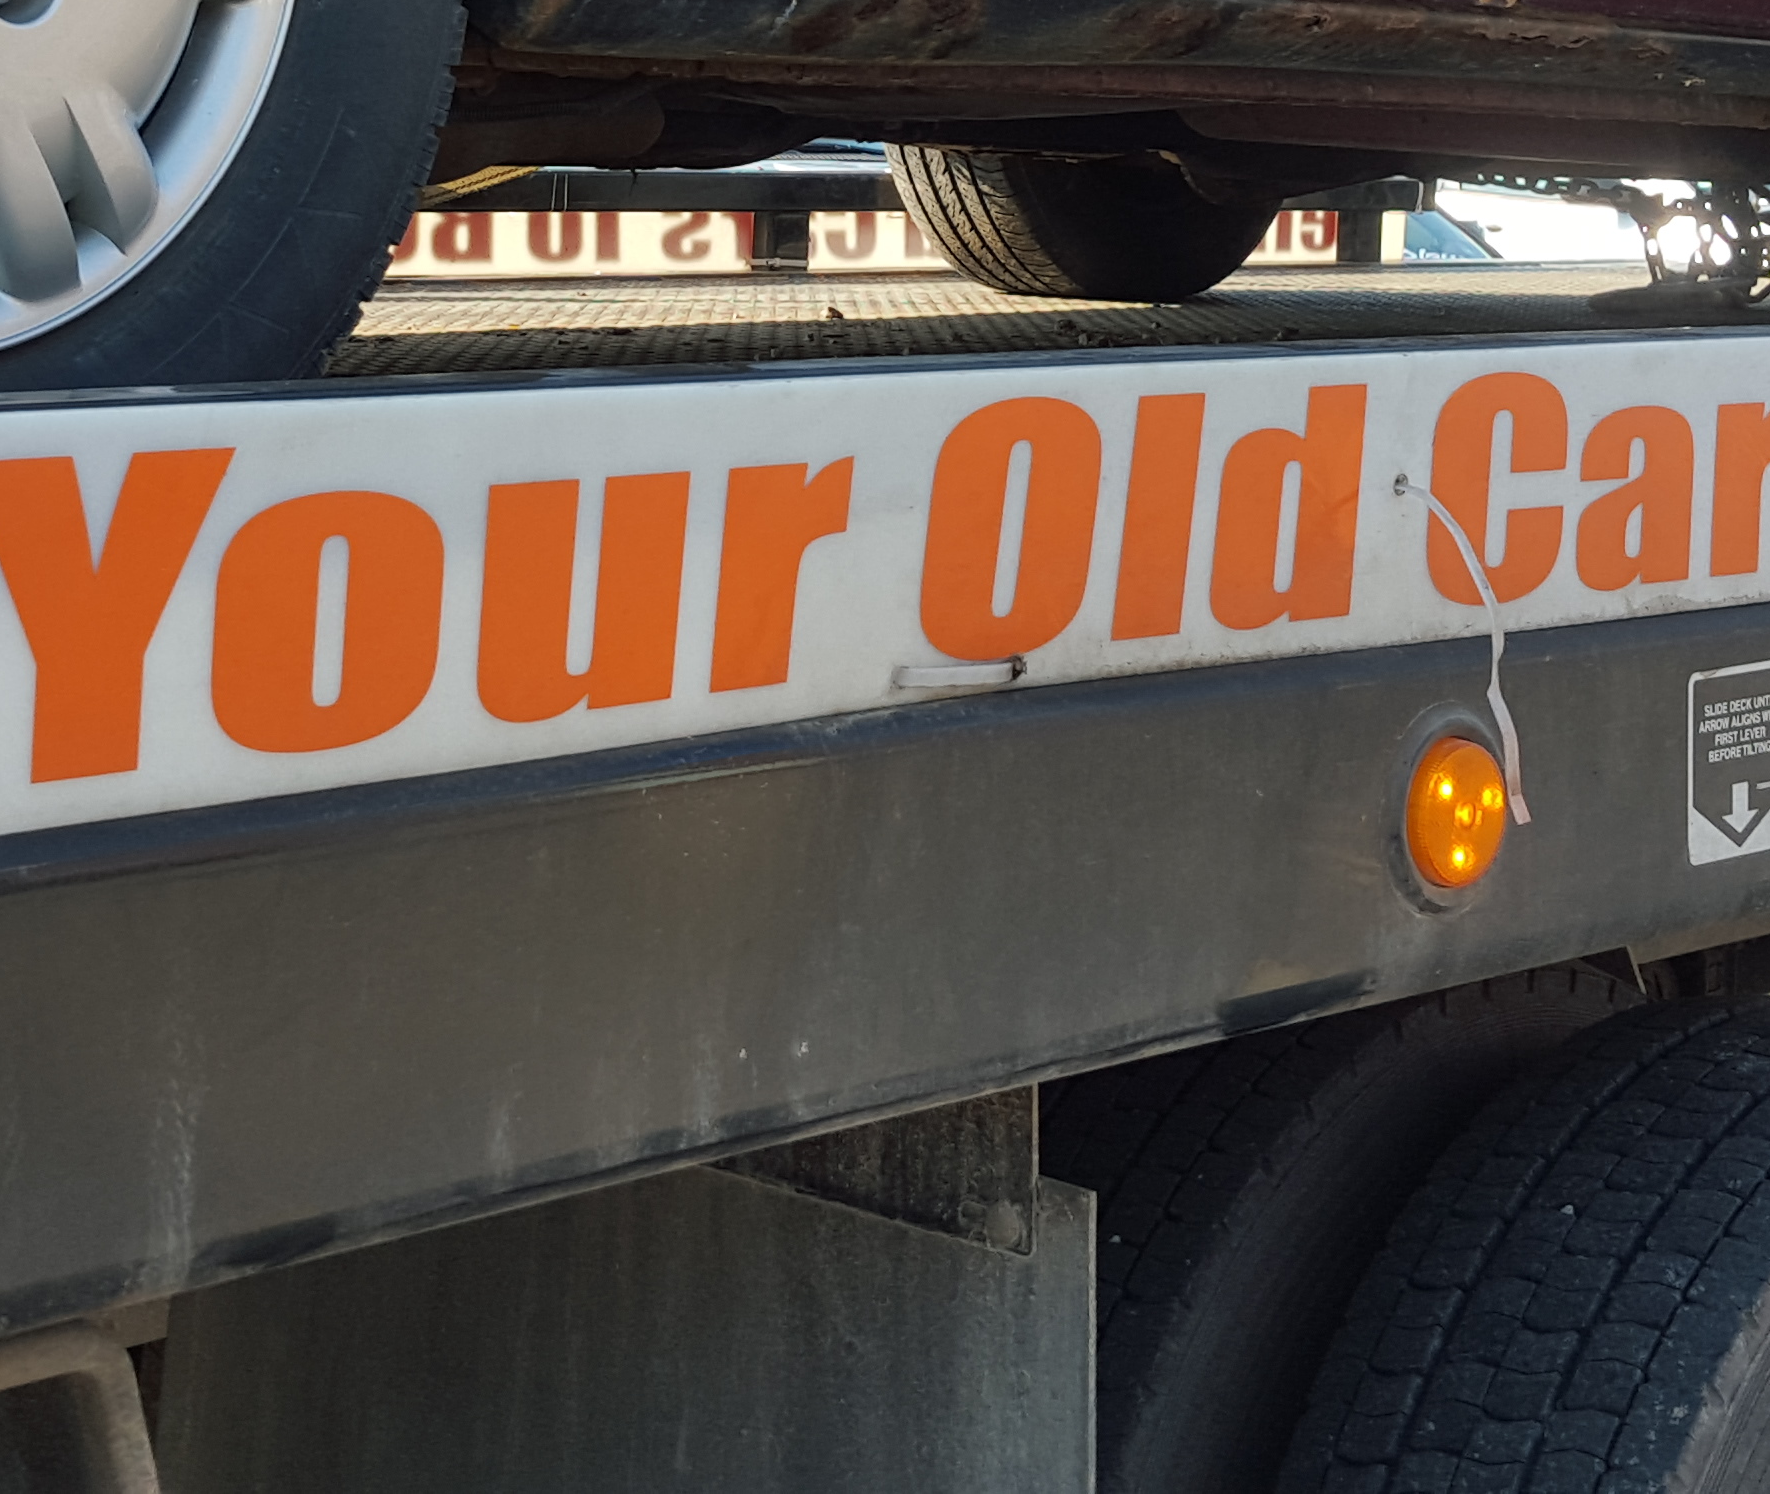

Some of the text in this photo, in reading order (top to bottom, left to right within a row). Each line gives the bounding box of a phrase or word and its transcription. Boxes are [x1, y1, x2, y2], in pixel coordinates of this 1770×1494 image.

[920, 384, 1368, 662] Old
[1704, 702, 1728, 717] SLIDE
[1729, 698, 1753, 713] DECK
[1699, 717, 1730, 734] ARROW
[1731, 711, 1761, 728] ALIGNS
[1715, 726, 1766, 746] FIRST LEVER
[1708, 746, 1741, 763] BEFORE
